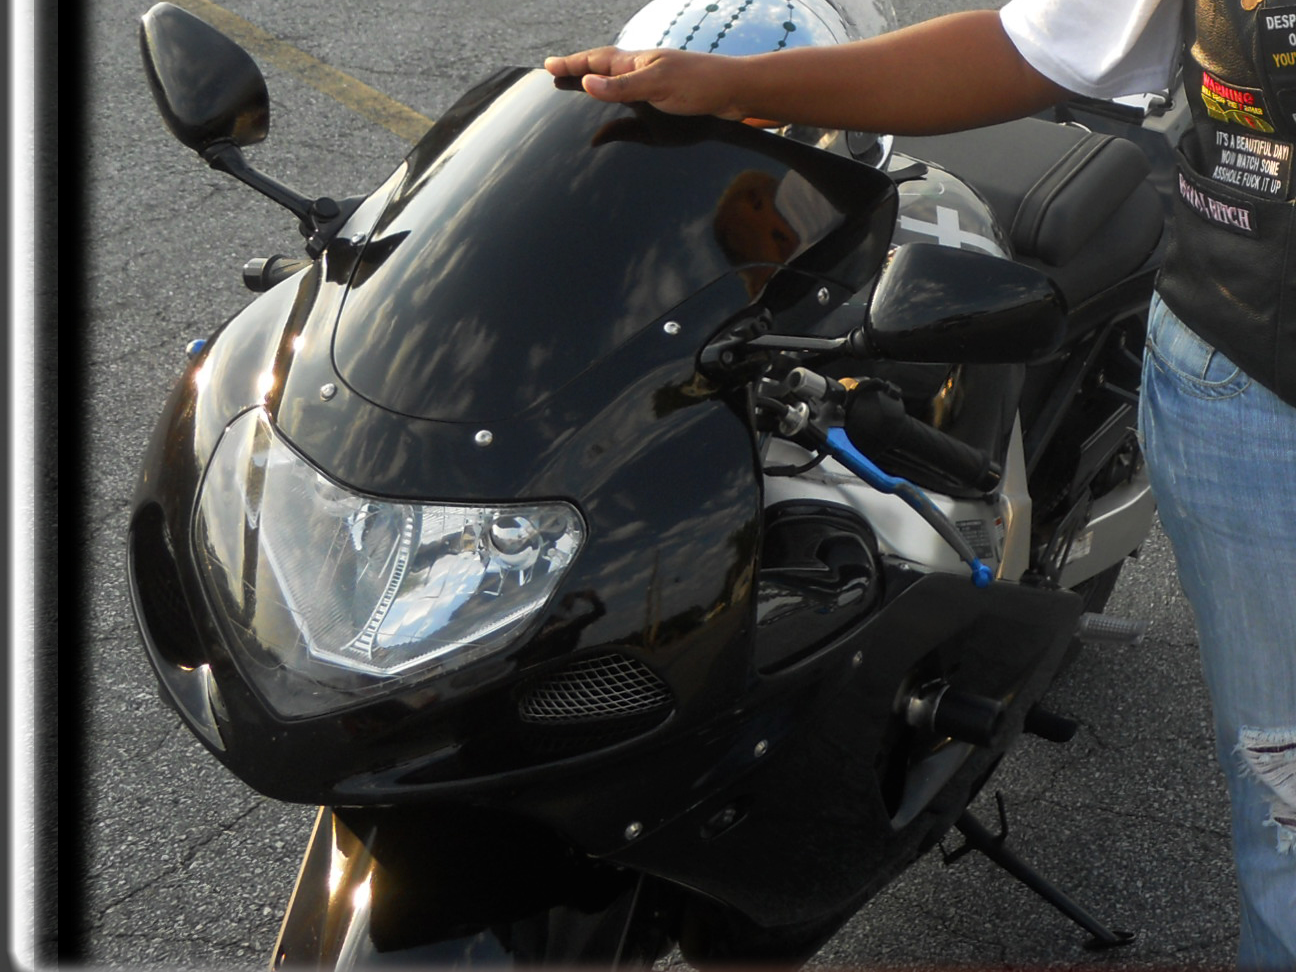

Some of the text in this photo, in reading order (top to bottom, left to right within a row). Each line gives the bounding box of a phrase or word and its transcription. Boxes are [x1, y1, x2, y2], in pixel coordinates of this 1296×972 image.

[1203, 71, 1255, 105] WARNING
[1216, 130, 1229, 147] IT'S
[1230, 134, 1235, 148] A
[1236, 135, 1272, 157] BEAUTIFUL
[1221, 149, 1280, 176] NOW WATCH SOME
[1212, 165, 1281, 195] ASSHOLE FUCK IT UP
[1207, 196, 1252, 231] BITCH
